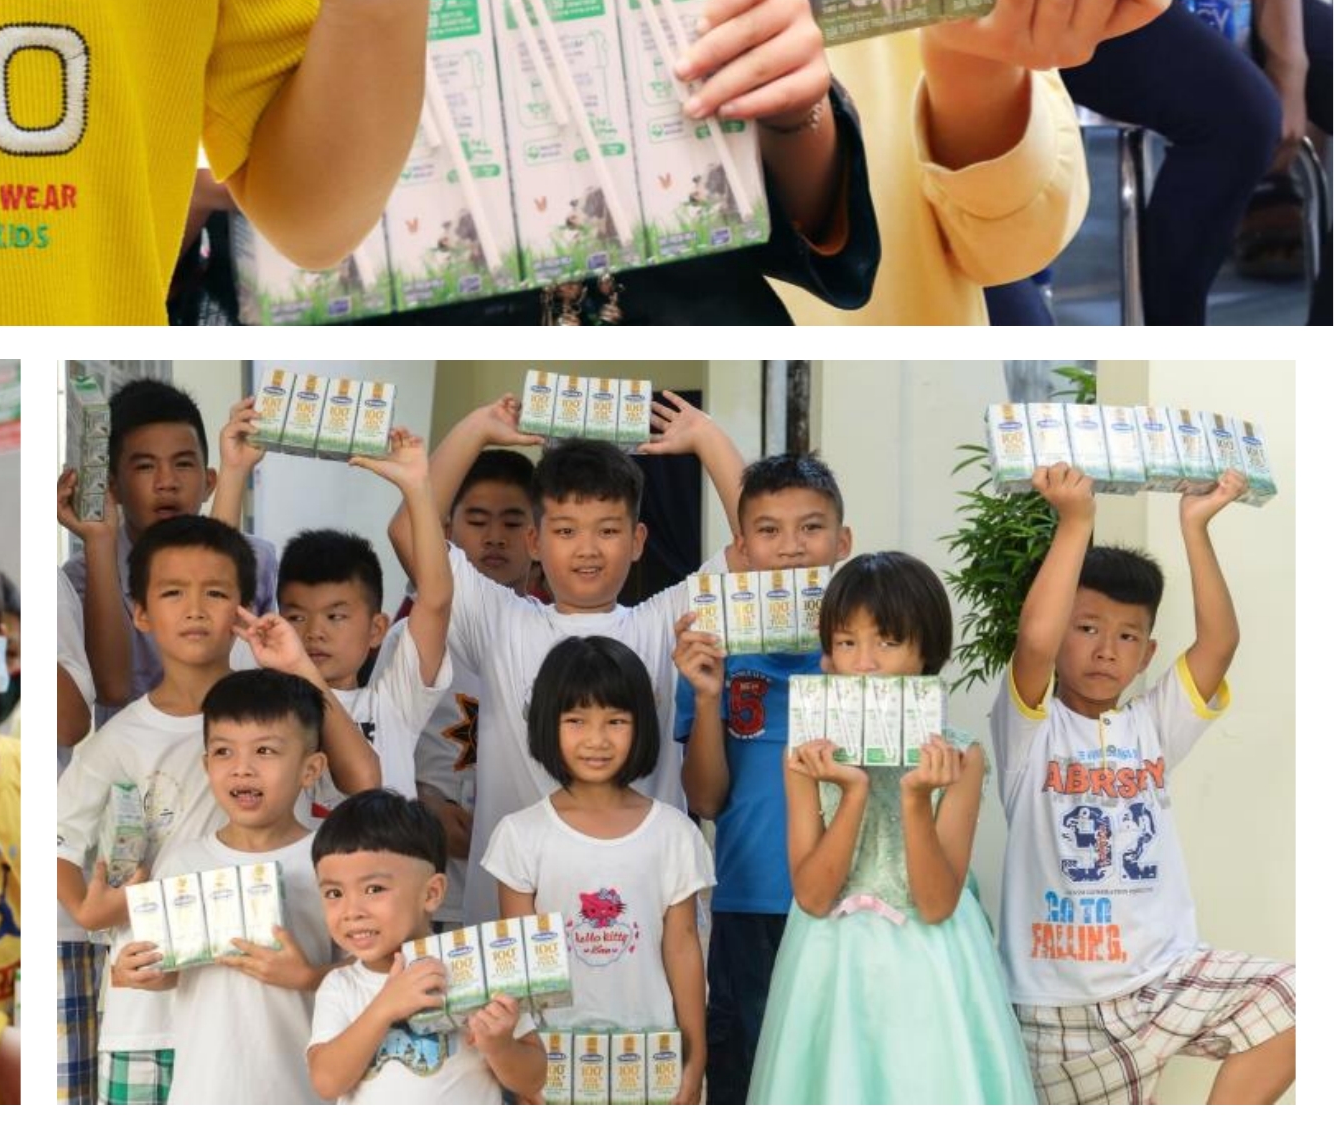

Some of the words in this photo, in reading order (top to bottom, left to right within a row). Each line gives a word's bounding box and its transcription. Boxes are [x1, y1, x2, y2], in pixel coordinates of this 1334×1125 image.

[0, 184, 77, 209] WEAR
[730, 677, 769, 735] 5
[1080, 897, 1111, 923] TO
